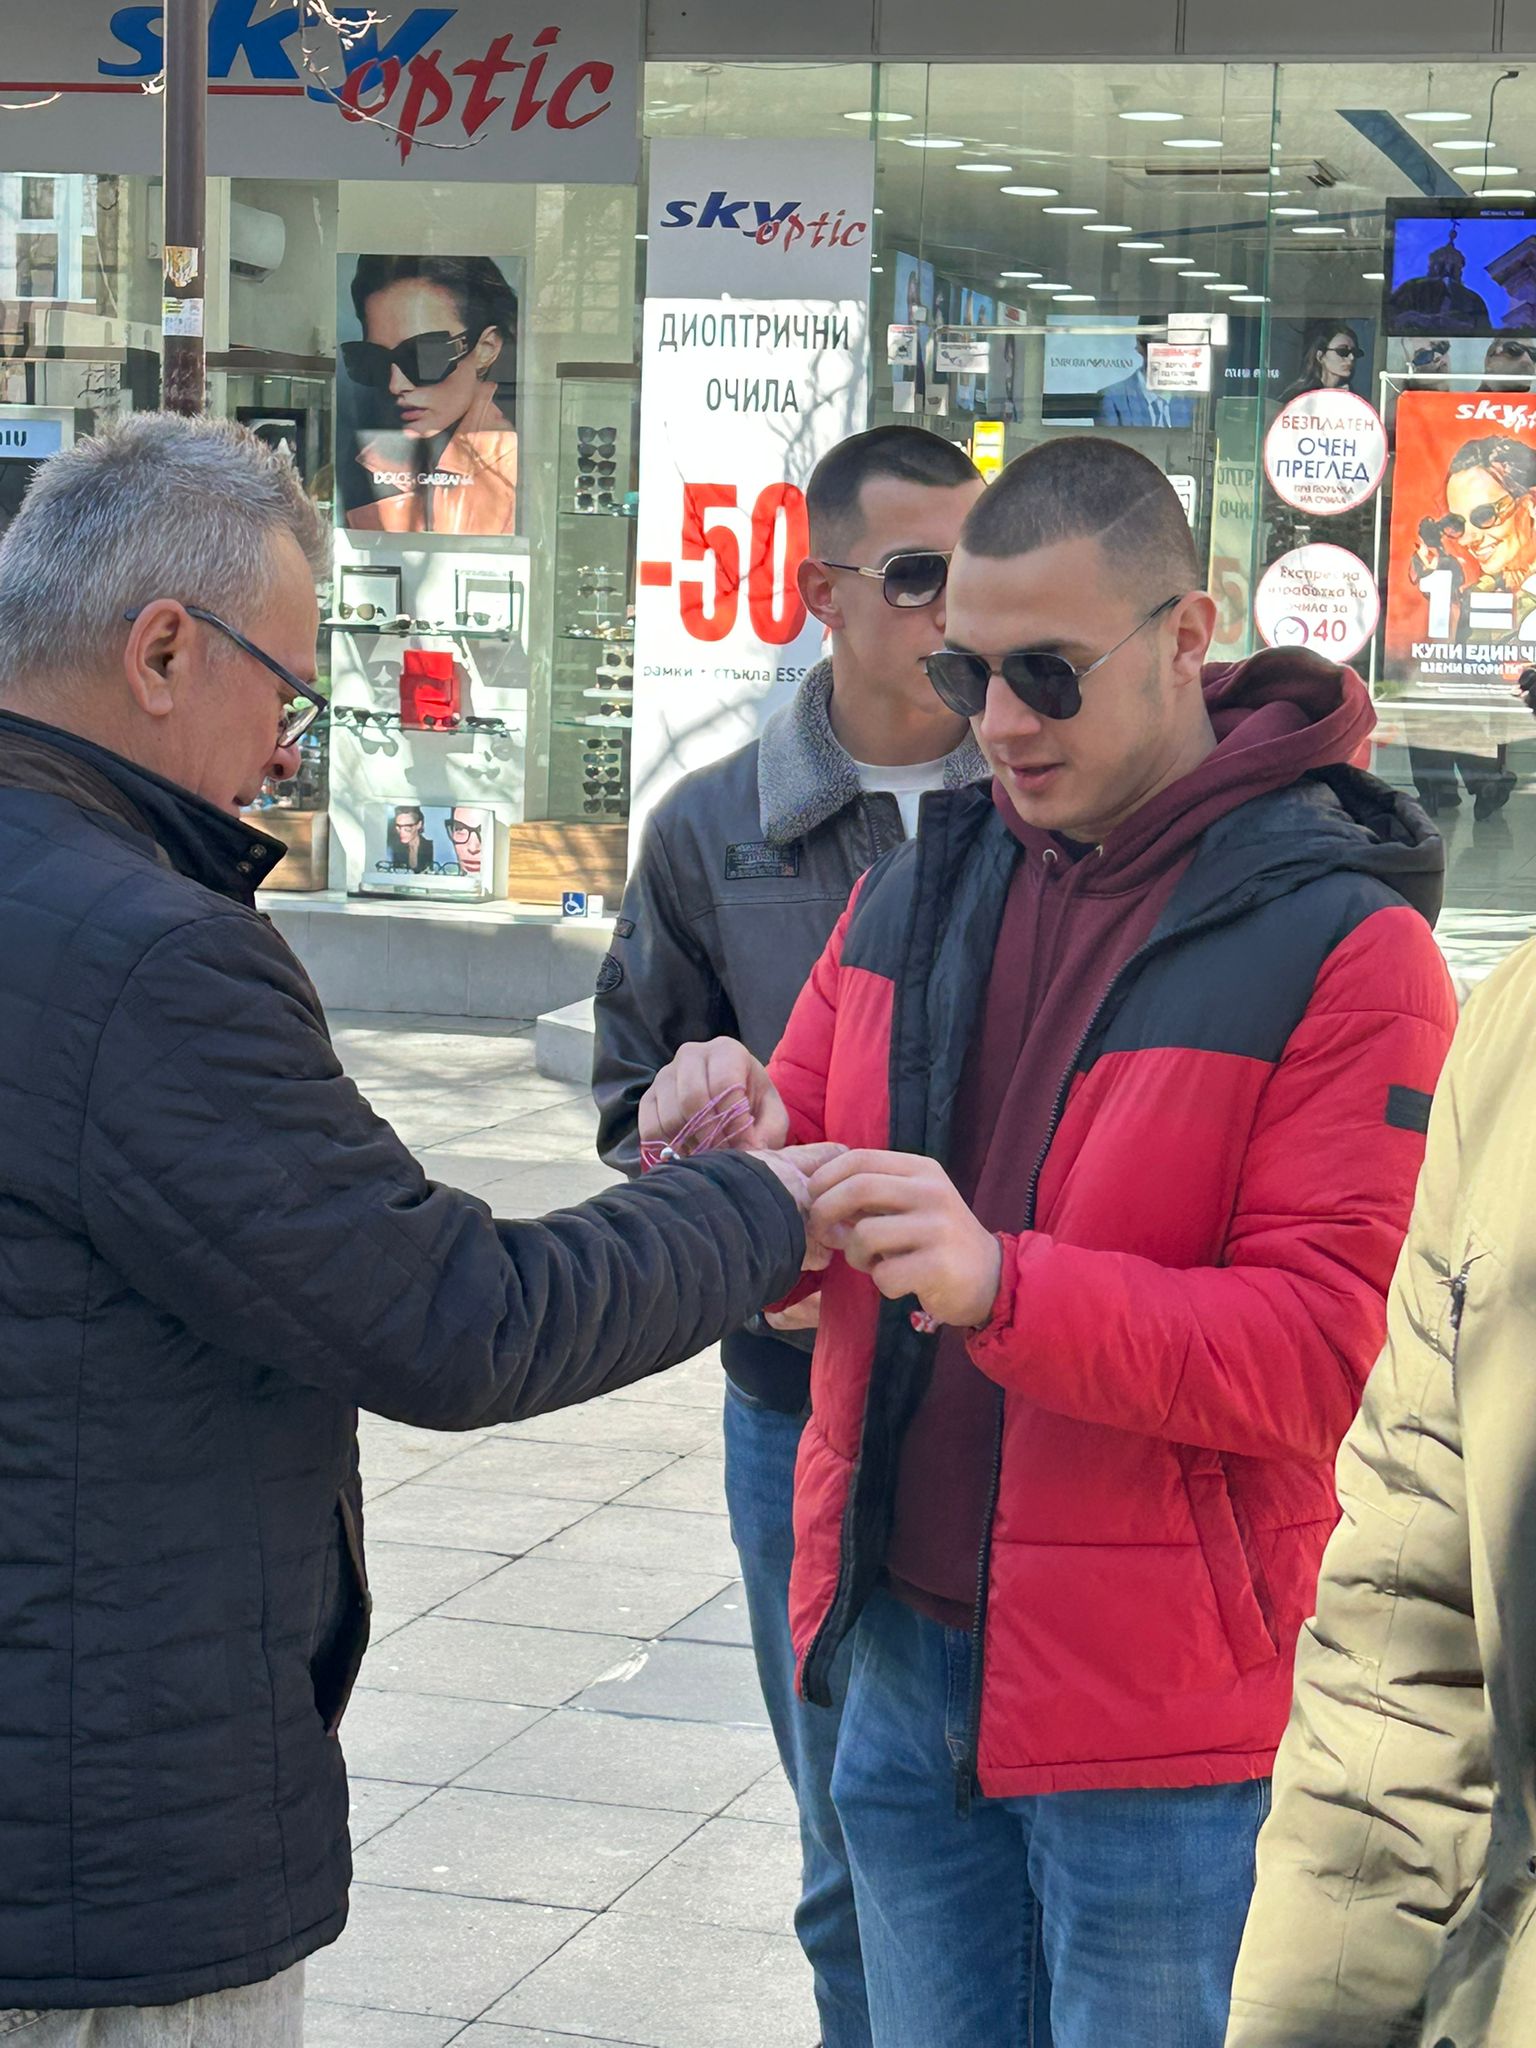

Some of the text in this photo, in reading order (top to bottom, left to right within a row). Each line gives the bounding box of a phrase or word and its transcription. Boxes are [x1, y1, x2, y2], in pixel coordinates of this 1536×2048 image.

[340, 26, 614, 167] optic
[755, 209, 867, 252] optic
[658, 313, 849, 352] ДИОПТРИЧНИ
[706, 378, 799, 413] ОЧИЛА
[1281, 415, 1374, 431] БЕЗПЛАТЕН
[1298, 437, 1356, 456] ОЧЕН
[1276, 459, 1370, 483] ПРЕГЛЕД
[640, 482, 833, 646] -50
[1280, 565, 1360, 581] Експрена
[1268, 583, 1345, 598] иработка
[1289, 602, 1328, 613] чила
[1313, 618, 1347, 642] 40
[1411, 642, 1463, 660] КУПИ
[1465, 644, 1518, 663] ЕДИН
[714, 668, 770, 682] стъкла
